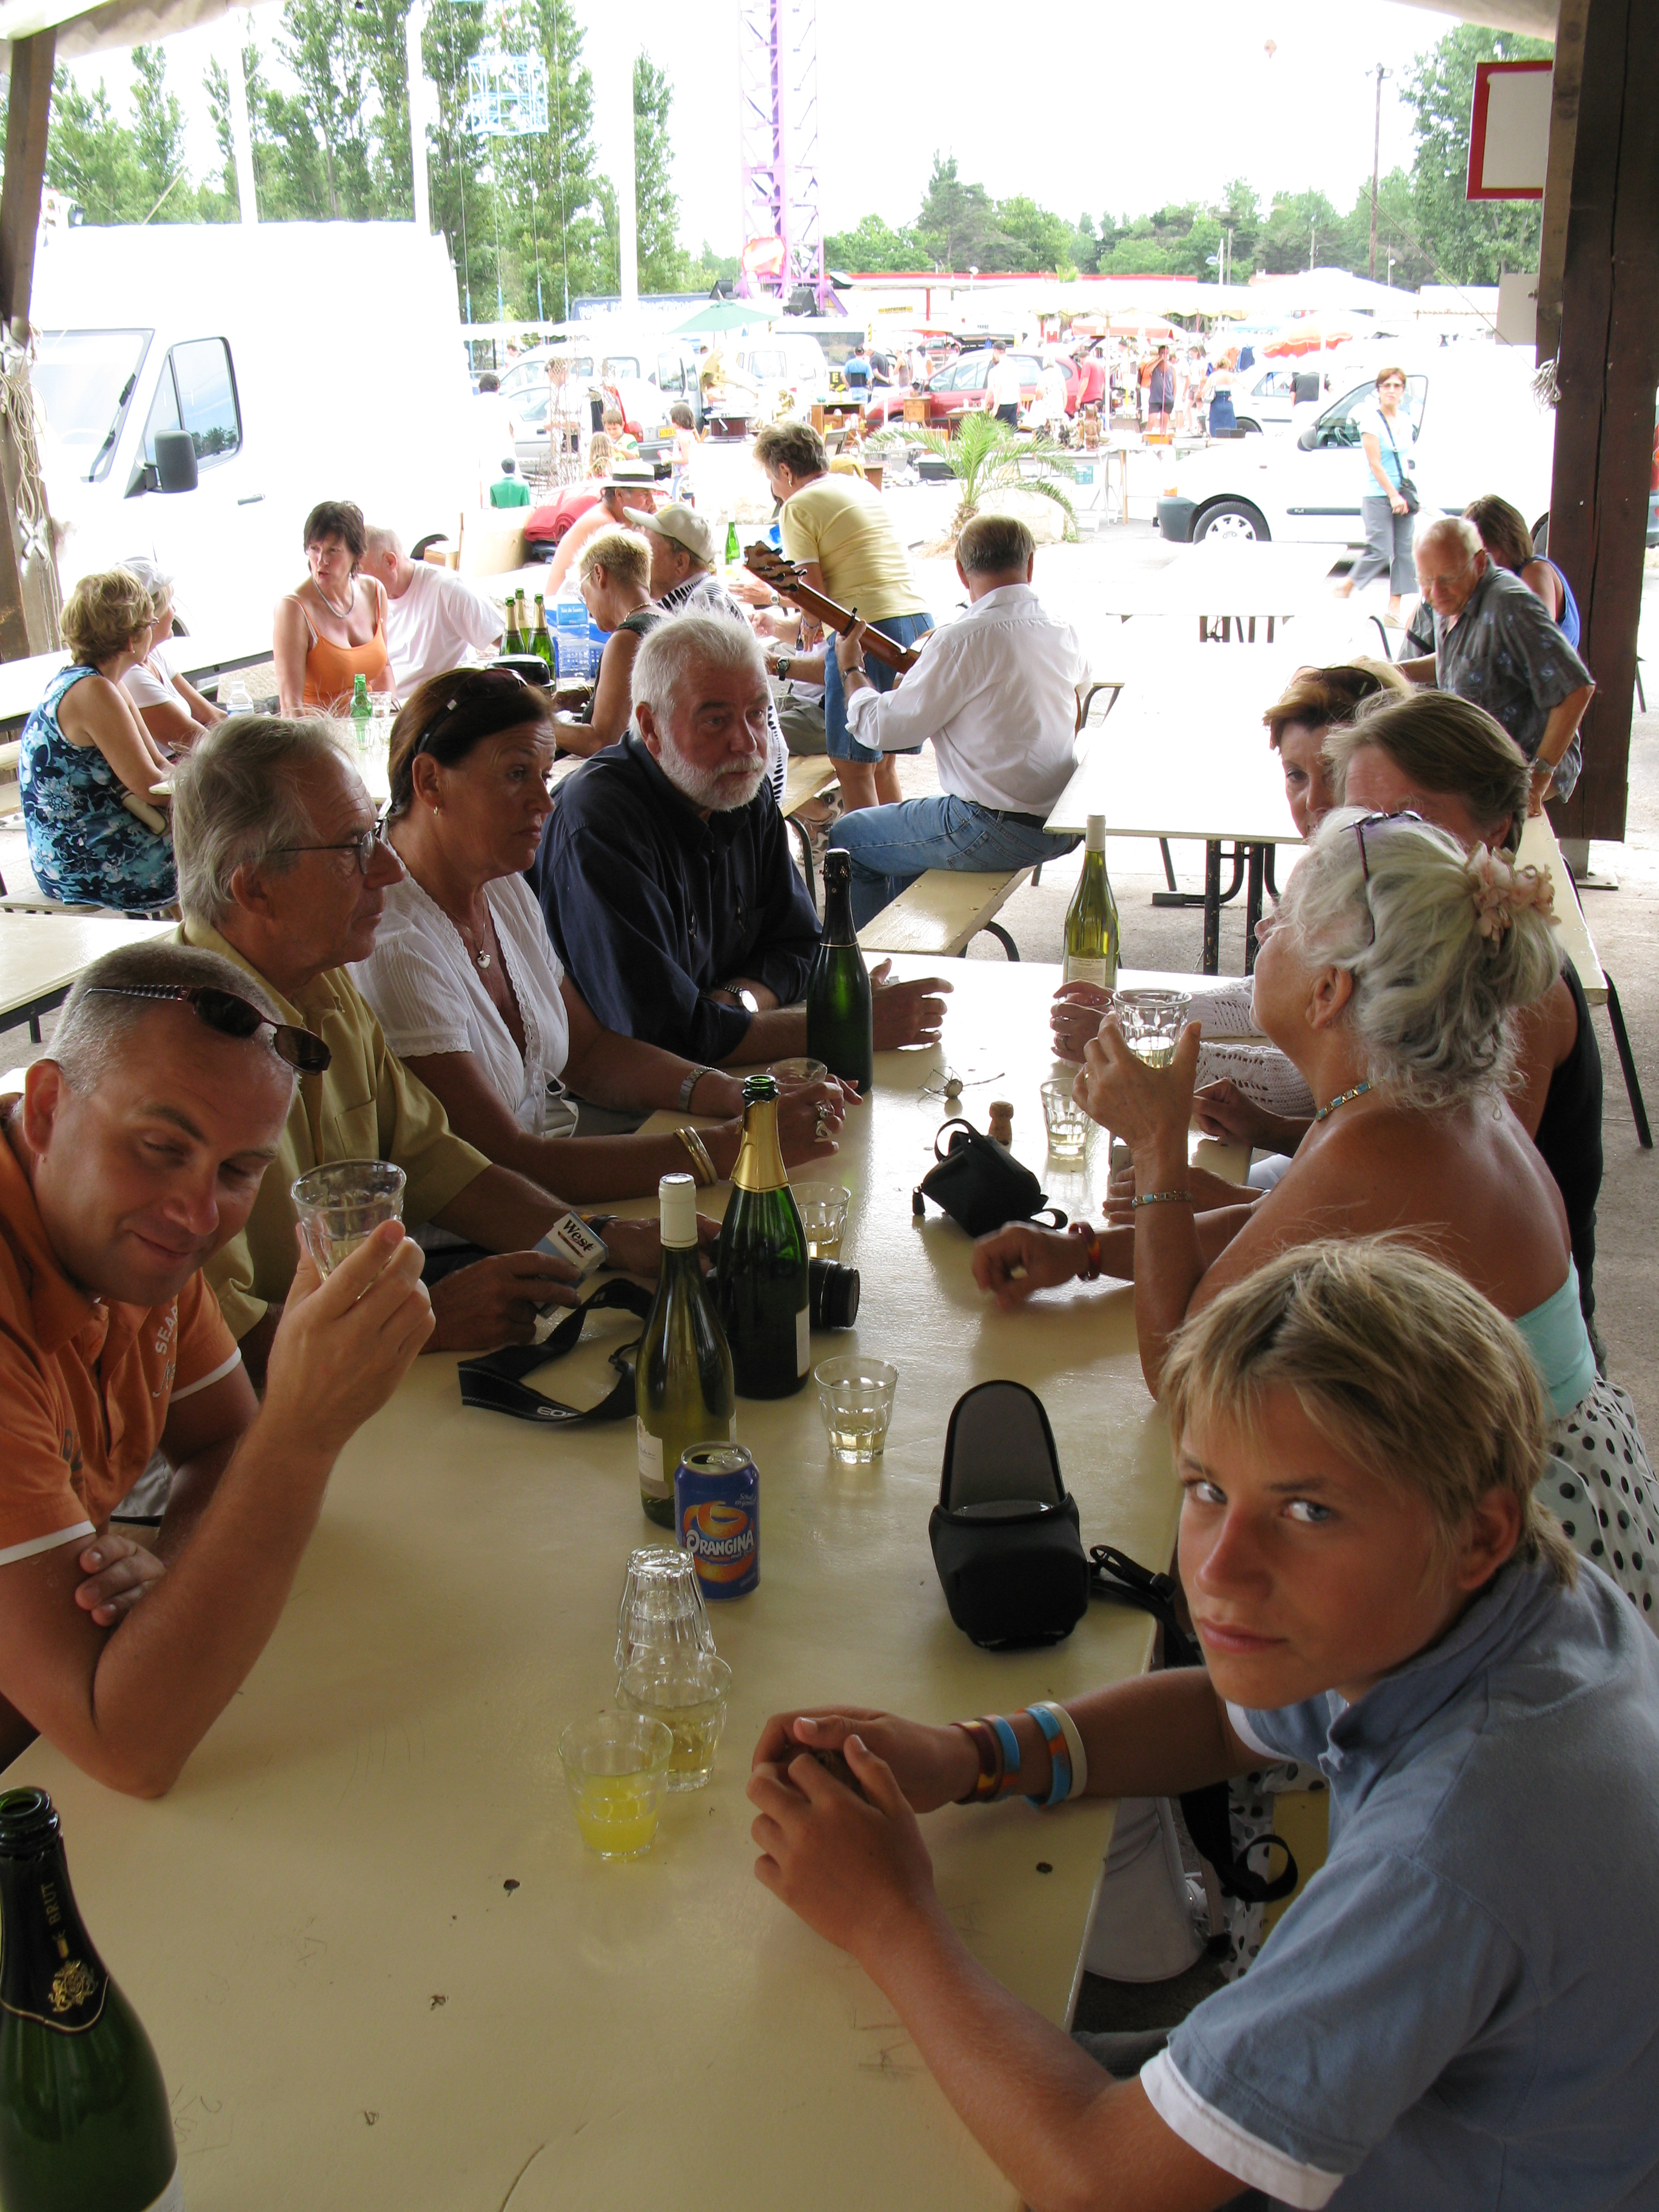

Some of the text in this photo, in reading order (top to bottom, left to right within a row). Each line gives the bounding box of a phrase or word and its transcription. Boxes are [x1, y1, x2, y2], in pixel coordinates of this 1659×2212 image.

[563, 1219, 594, 1252] West
[686, 1529, 754, 1556] ORANGINA
[42, 1882, 61, 1926] BRUT
